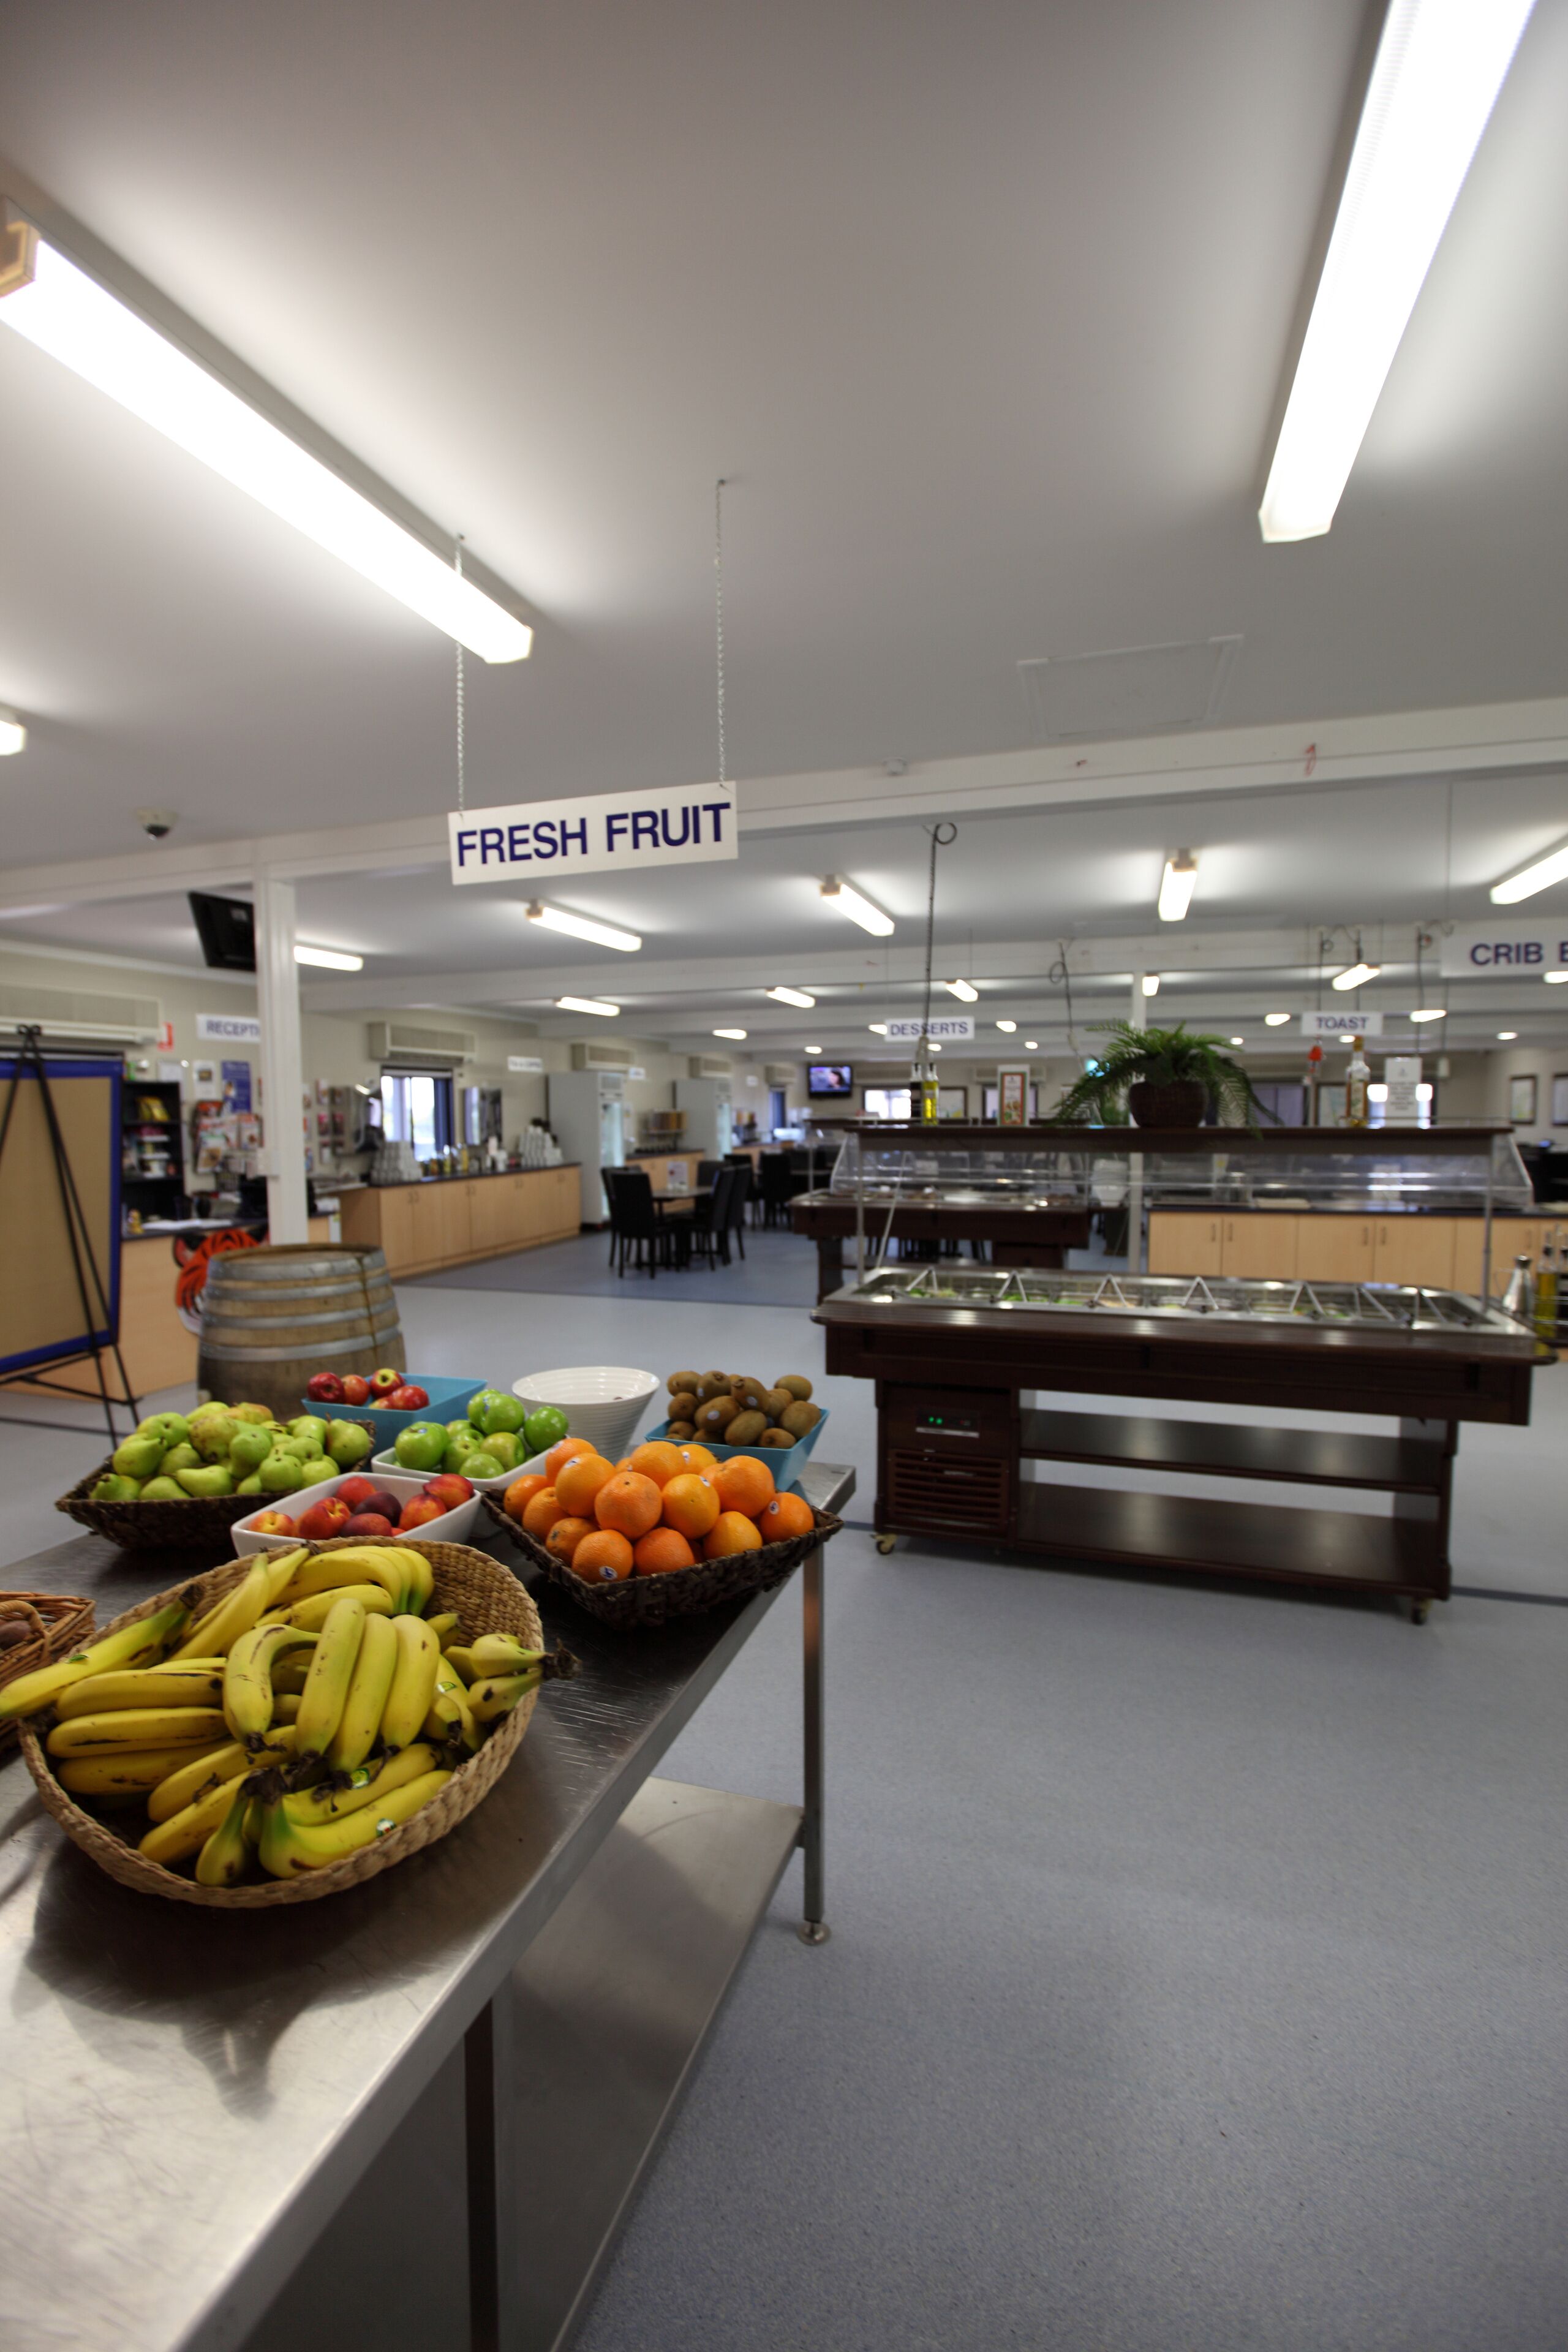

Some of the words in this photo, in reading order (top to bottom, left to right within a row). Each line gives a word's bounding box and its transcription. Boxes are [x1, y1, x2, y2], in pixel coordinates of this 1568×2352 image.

[458, 817, 587, 867] FRESH
[606, 802, 731, 852] FRUIT
[1471, 942, 1544, 966] CRIB
[1316, 1016, 1369, 1030] TOAST
